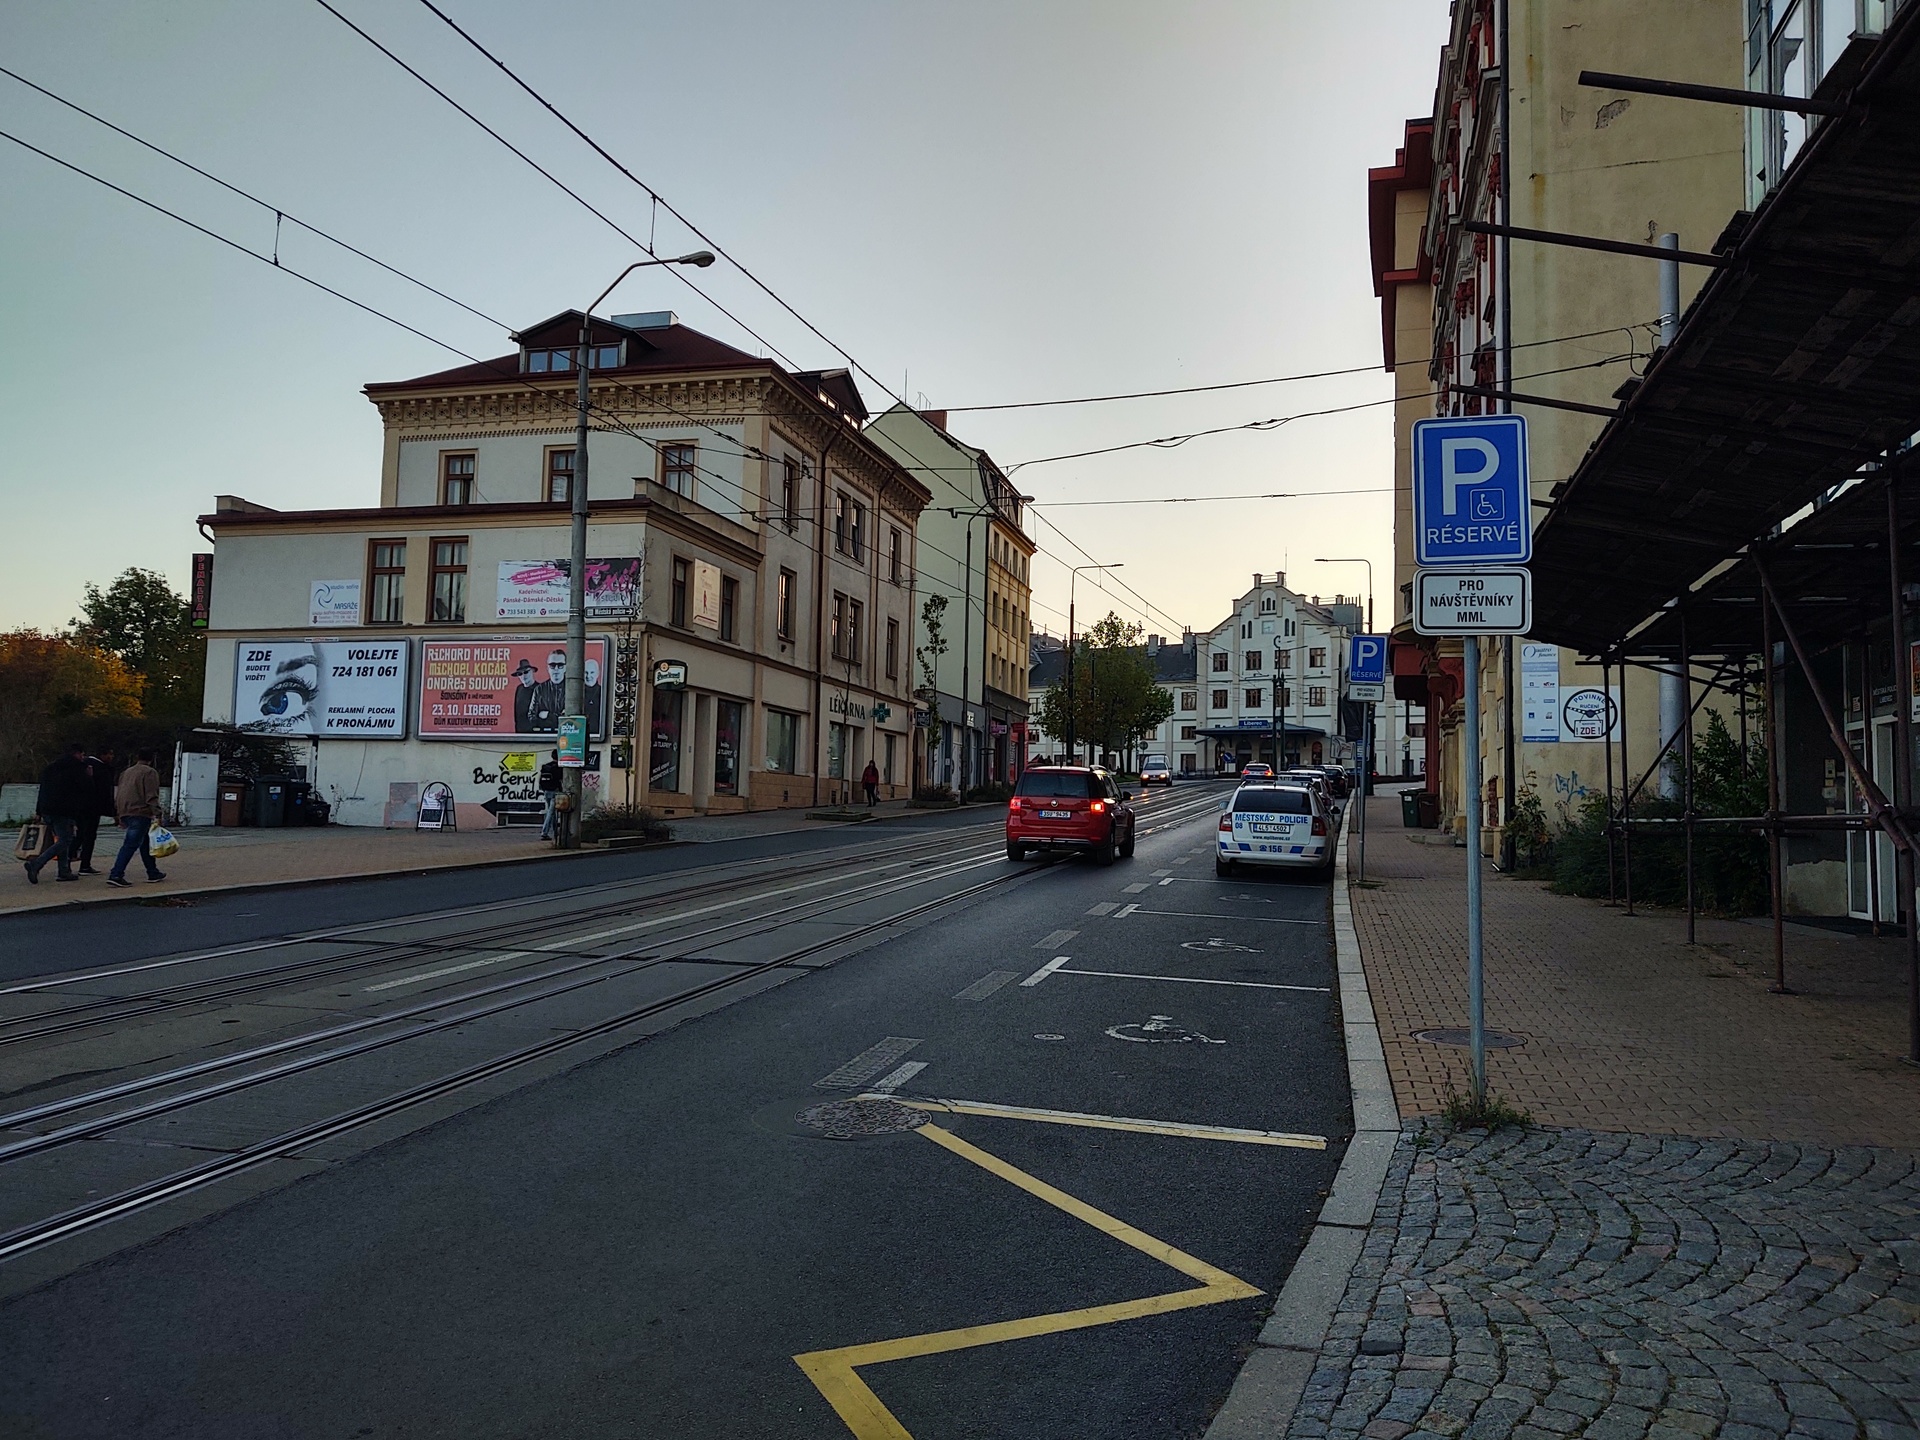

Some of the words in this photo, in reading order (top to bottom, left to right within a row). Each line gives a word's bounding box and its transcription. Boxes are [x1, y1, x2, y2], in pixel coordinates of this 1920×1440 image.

[1441, 437, 1500, 516] P
[1427, 521, 1519, 544] RÉSERVÉ
[196, 555, 205, 610] PENALTA
[1459, 579, 1484, 591] PRO
[1430, 593, 1514, 607] NÁVŠTĚVNÍKY
[1457, 611, 1486, 623] MML
[247, 650, 272, 662] ZDE
[348, 650, 398, 660] VOLEJTE
[474, 648, 510, 660] MÜLLER
[1357, 641, 1378, 668] P
[332, 666, 352, 677] 724
[356, 666, 374, 677] 181
[378, 666, 398, 676] 061
[474, 660, 507, 675] KOCÁB
[1352, 670, 1382, 678] RÉSERVÉ
[469, 677, 508, 690] SOUKUP
[1887, 685, 1897, 693] POLIC
[432, 704, 445, 716] 23.
[447, 704, 461, 716] 10.
[464, 704, 501, 716] LIBEREC
[327, 719, 334, 727] K
[336, 716, 395, 728] PRONÁJMU
[434, 717, 445, 725] DŮM
[473, 718, 498, 726] LIBEREC
[473, 767, 498, 784] Bar
[1235, 814, 1269, 822] MĚSTSKÁ
